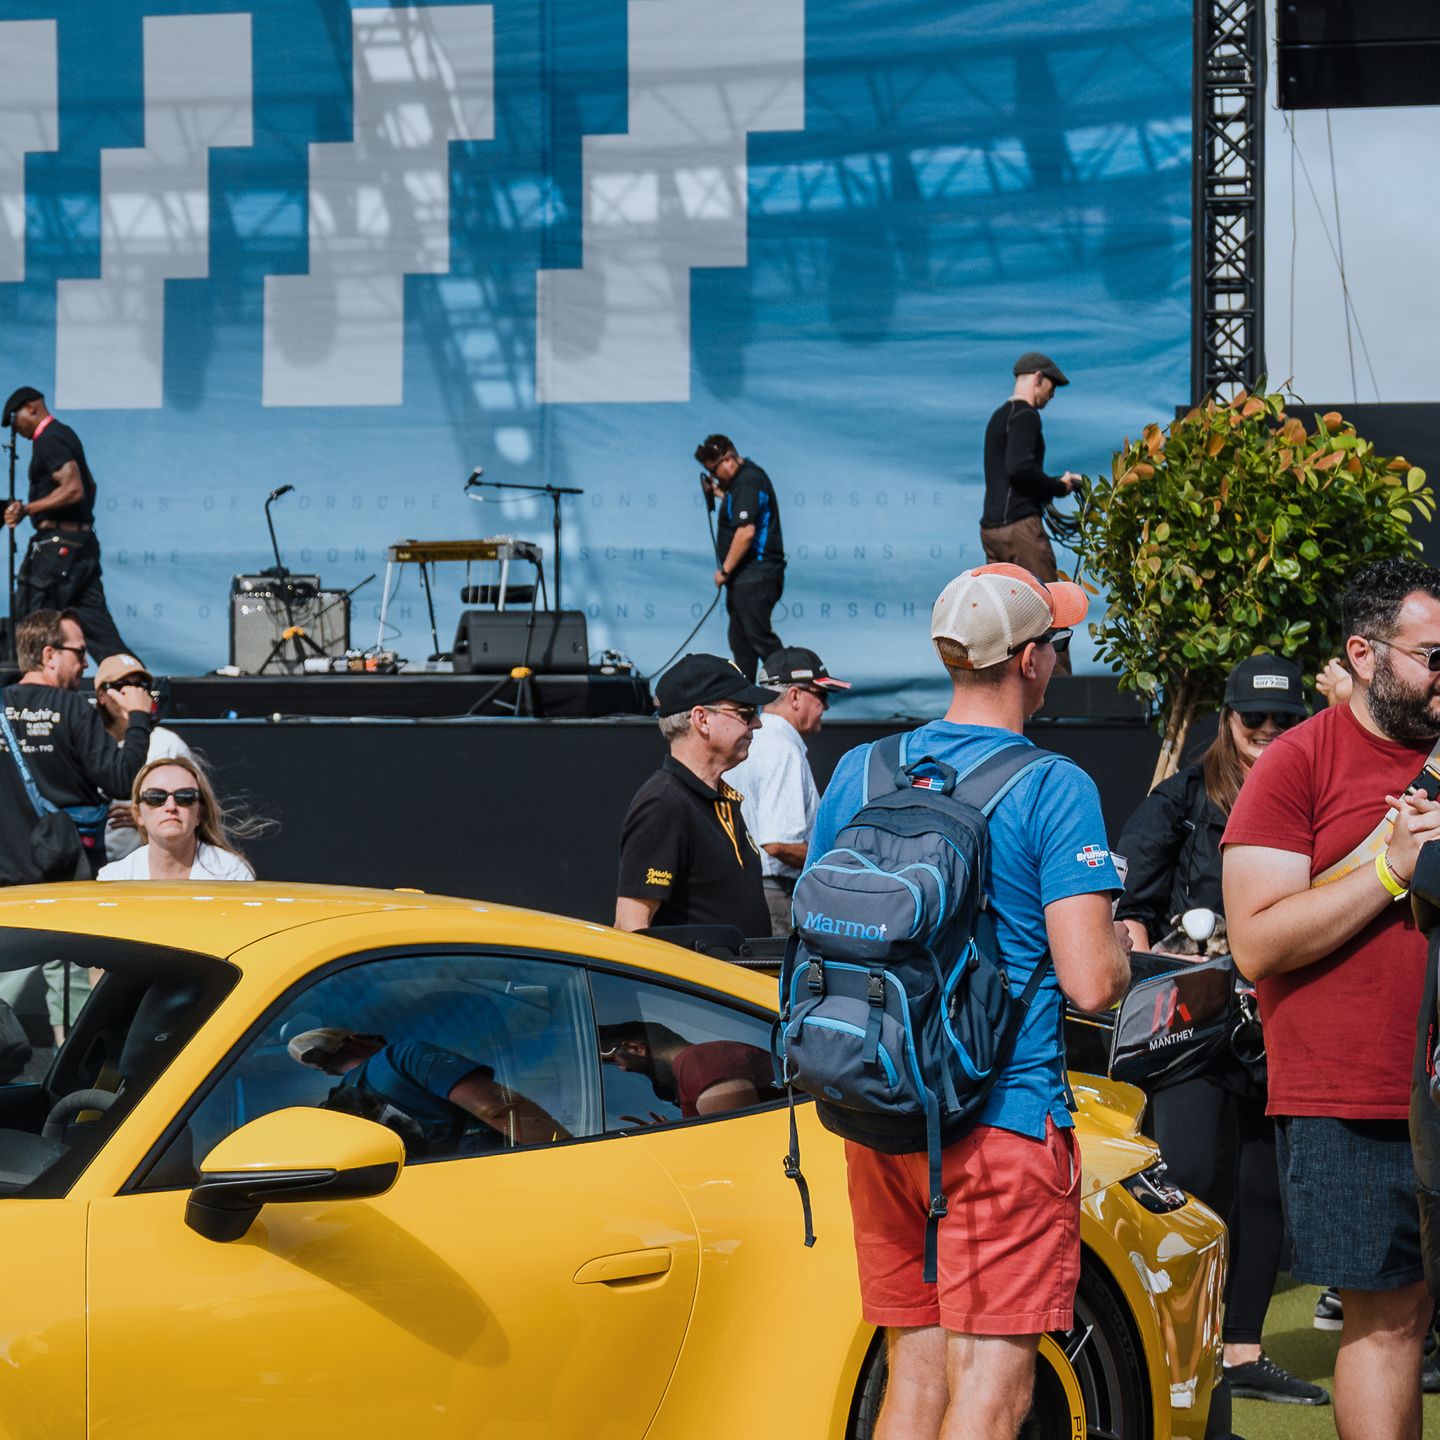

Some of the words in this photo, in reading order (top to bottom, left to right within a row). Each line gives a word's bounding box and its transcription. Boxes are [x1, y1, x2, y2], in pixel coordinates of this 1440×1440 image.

[105, 496, 170, 511] ONS
[274, 493, 440, 511] ORSCHE
[793, 490, 943, 508] ORSCHE
[796, 543, 894, 560] CONS
[792, 601, 915, 619] ORSCH
[802, 911, 888, 942] Marmot
[1149, 1027, 1194, 1051] MANTHEY
